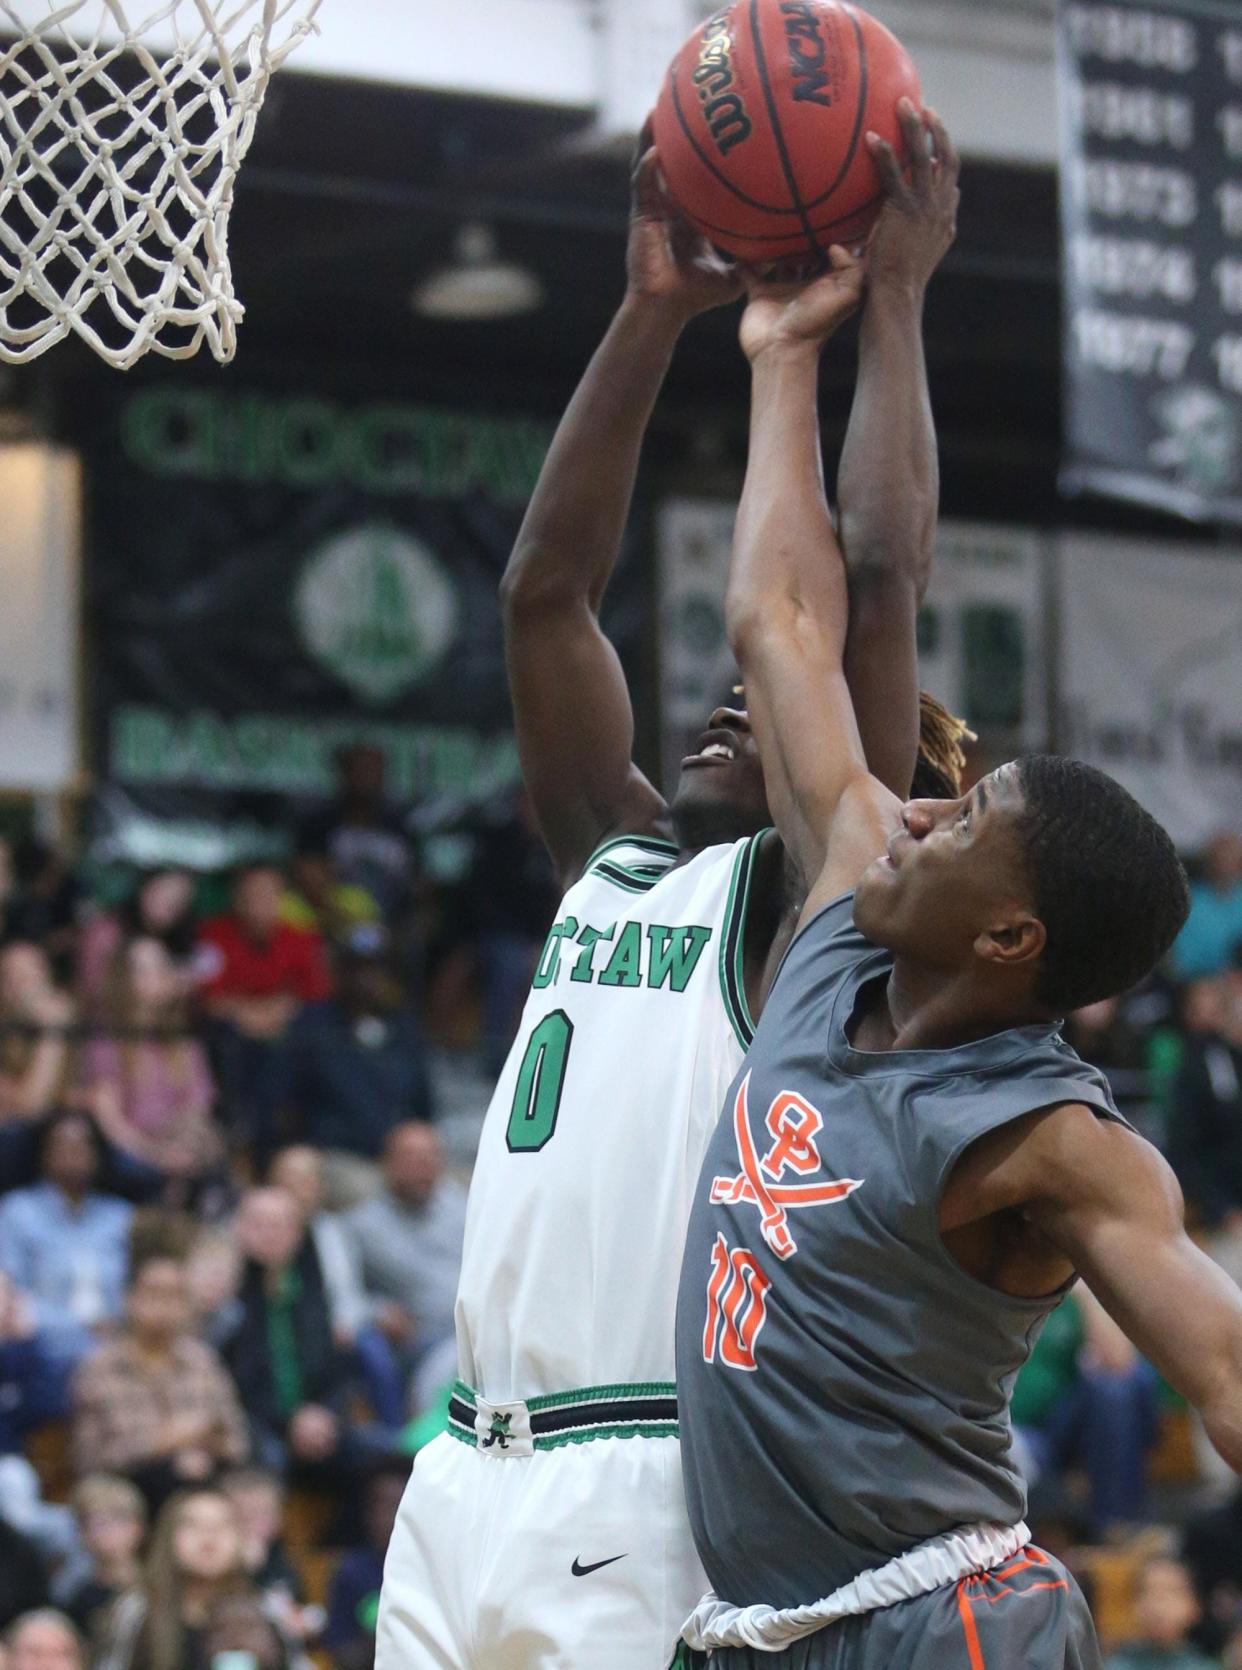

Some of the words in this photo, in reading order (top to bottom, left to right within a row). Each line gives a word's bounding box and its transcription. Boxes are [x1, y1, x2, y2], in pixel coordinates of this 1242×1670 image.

[691, 5, 754, 157] Wilso
[505, 1008, 575, 1154] 0
[702, 1231, 773, 1372] 10
